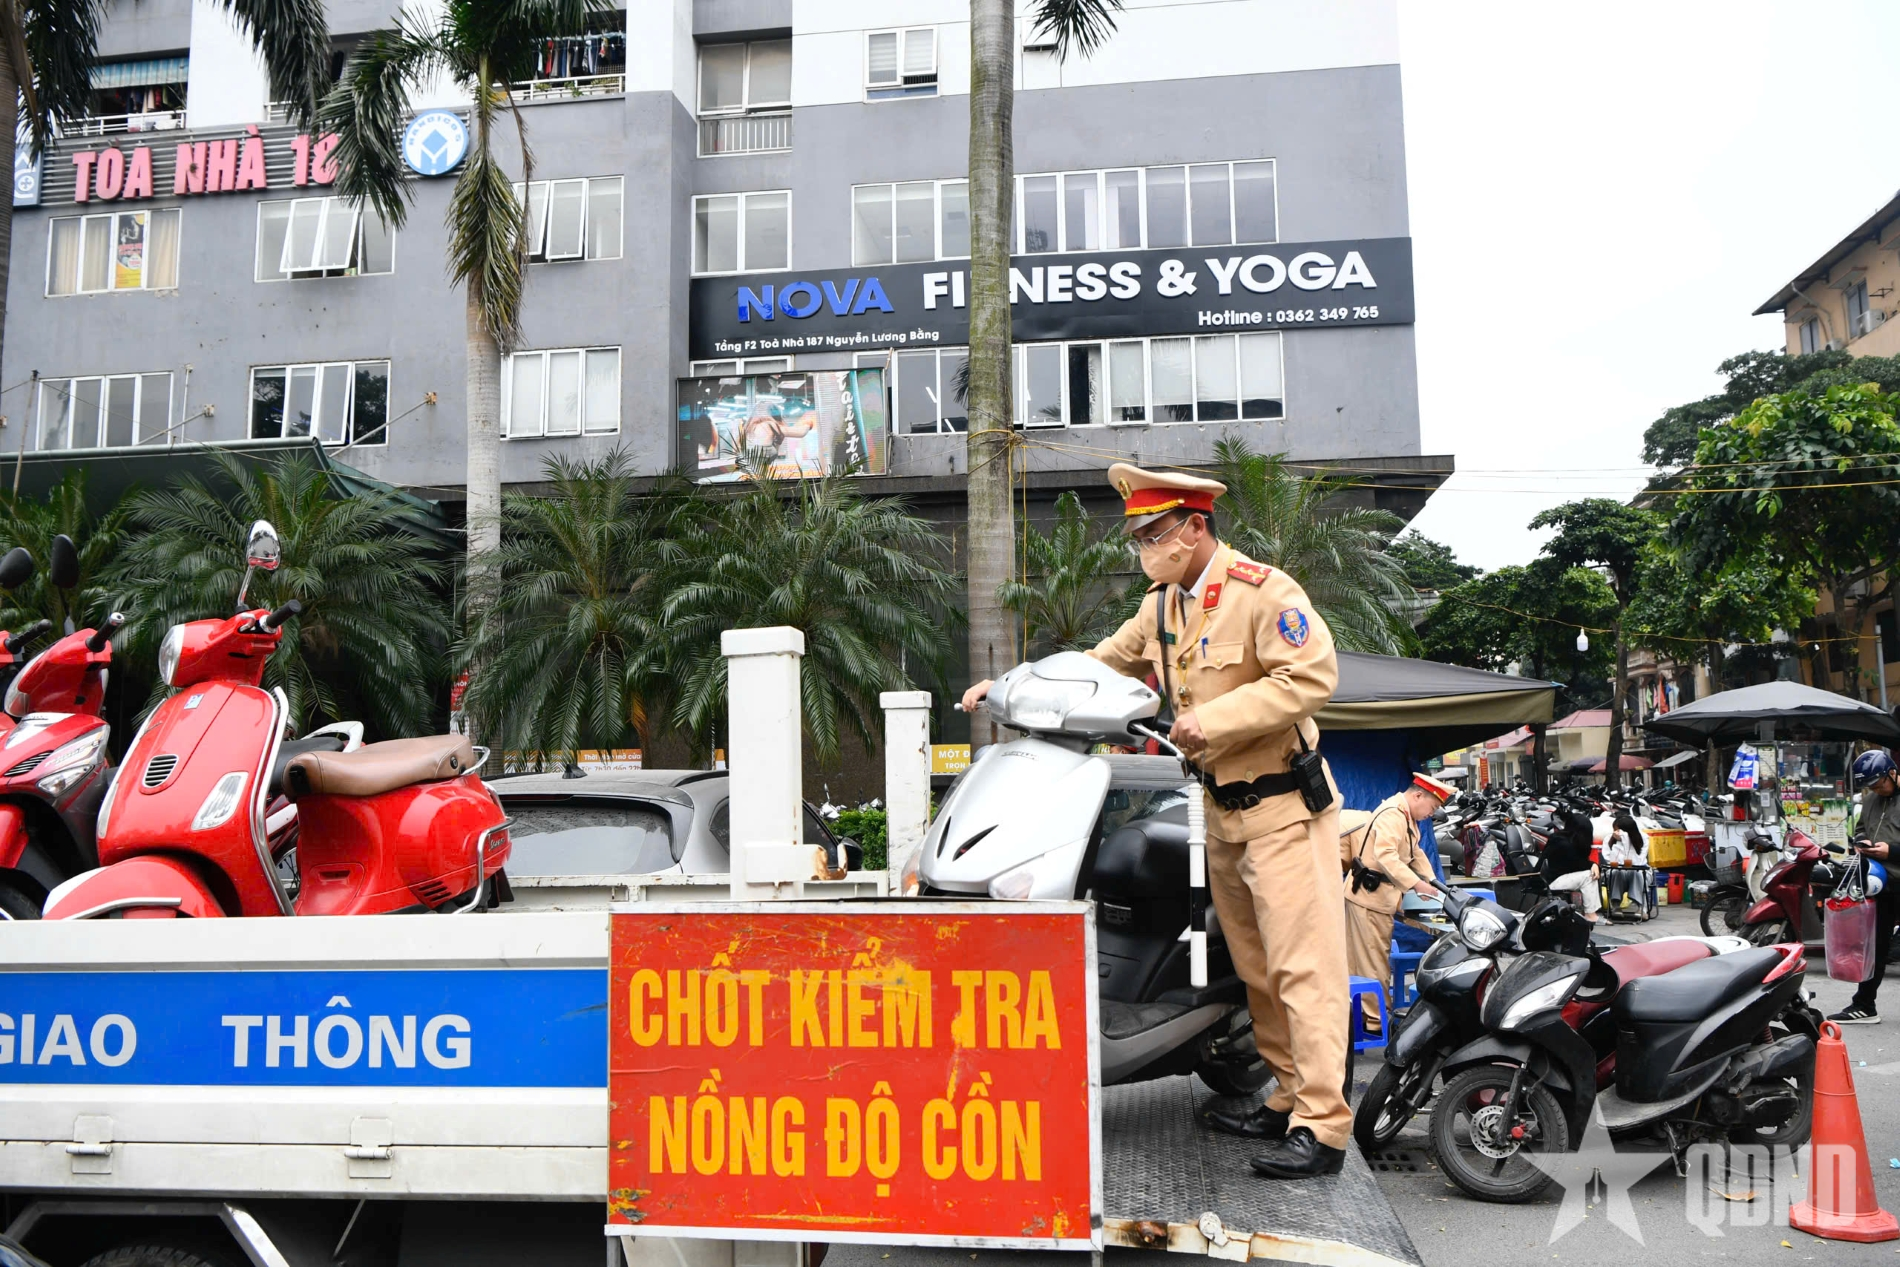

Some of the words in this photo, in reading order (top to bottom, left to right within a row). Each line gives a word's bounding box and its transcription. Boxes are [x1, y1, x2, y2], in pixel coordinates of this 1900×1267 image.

[173, 124, 267, 195] NHÀ
[290, 131, 351, 187] 18
[737, 277, 895, 323] NOVA
[923, 261, 1142, 310] FINESS
[1156, 259, 1198, 298] &
[1204, 250, 1378, 296] YOGA
[1198, 309, 1263, 326] Hotline
[1276, 309, 1315, 323] 0362
[1319, 307, 1348, 321] 349
[1352, 305, 1379, 319] 765
[714, 339, 742, 353] Tầng
[744, 341, 757, 350] F2
[759, 338, 780, 349] Toà
[782, 337, 804, 348] Nhà
[806, 336, 824, 346] 187
[826, 332, 869, 347] Nguyễn
[872, 332, 907, 344] Lương
[909, 328, 940, 342] Bằng
[939, 749, 960, 760] MỘT
[629, 938, 770, 1047] CHỐT
[790, 936, 932, 1048] KIỂM
[951, 969, 1062, 1050] TRA
[0, 1013, 137, 1067] GIAO
[221, 995, 472, 1069] THÔNG
[649, 1068, 805, 1177] NỒNG
[824, 1081, 901, 1197] ĐỘ
[922, 1071, 1042, 1181] CỒN
